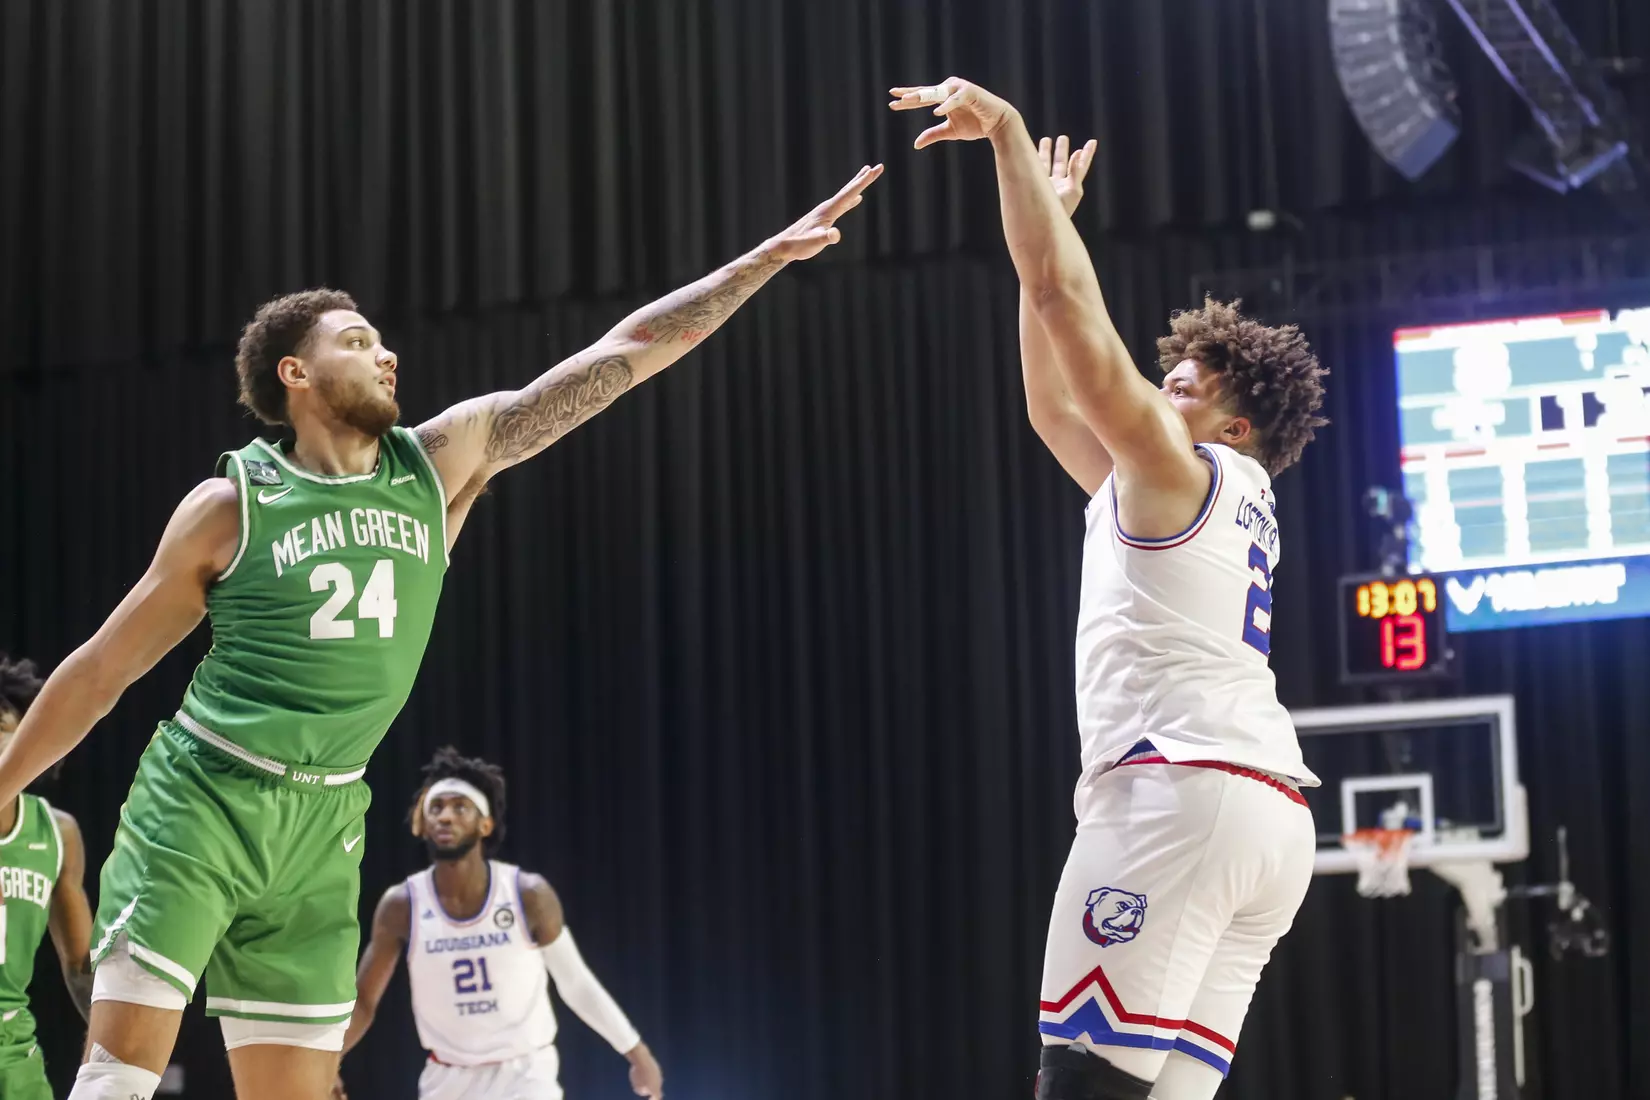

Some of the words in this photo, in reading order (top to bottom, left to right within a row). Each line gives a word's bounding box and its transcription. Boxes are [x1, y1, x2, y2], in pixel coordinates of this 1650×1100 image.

[271, 510, 347, 578] MEAN
[350, 507, 429, 565] GREEN
[308, 559, 398, 640] 24
[1357, 577, 1437, 619] 13:07
[1380, 612, 1426, 671] 13
[292, 771, 320, 785] UNT
[0, 865, 52, 910] GREEN
[425, 932, 511, 953] LOUISIANA
[452, 956, 493, 995] 21
[454, 999, 498, 1016] TECH
